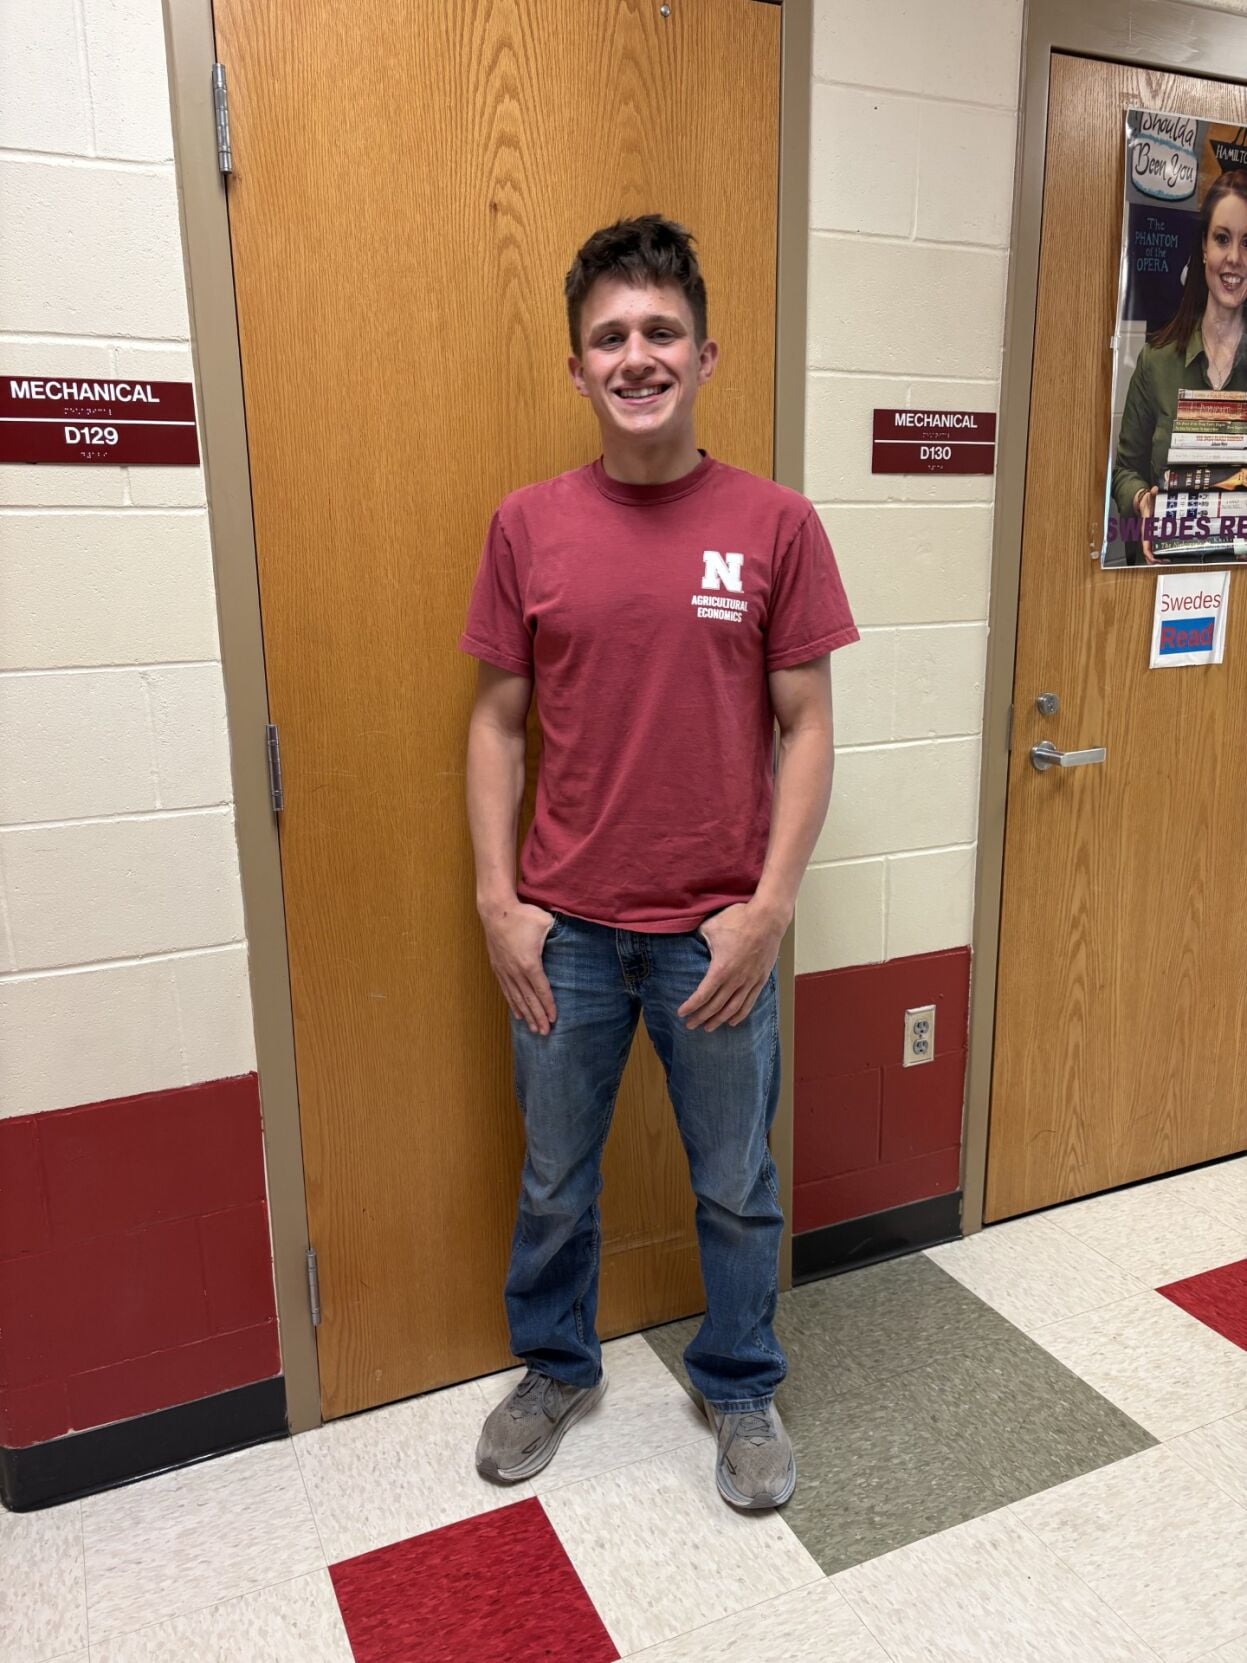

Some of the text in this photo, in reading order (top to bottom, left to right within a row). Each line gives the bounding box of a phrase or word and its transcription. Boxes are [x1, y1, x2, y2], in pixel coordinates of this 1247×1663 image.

[1143, 112, 1194, 147] Shoulda
[1134, 142, 1194, 188] Been You
[1146, 217, 1166, 231] The
[1135, 231, 1178, 249] PHANTOM
[1136, 257, 1169, 273] OPERA
[10, 380, 160, 403] MECHANICAL
[895, 413, 978, 428] MECHANICAL
[64, 426, 119, 445] D129
[920, 446, 952, 460] D130
[1107, 515, 1211, 543] SWEDES
[701, 550, 745, 594] N
[691, 595, 748, 612] AGRICULTURAL
[1161, 590, 1222, 612] Swedes
[697, 607, 742, 623] ECONOMICS
[1160, 623, 1214, 650] Read
